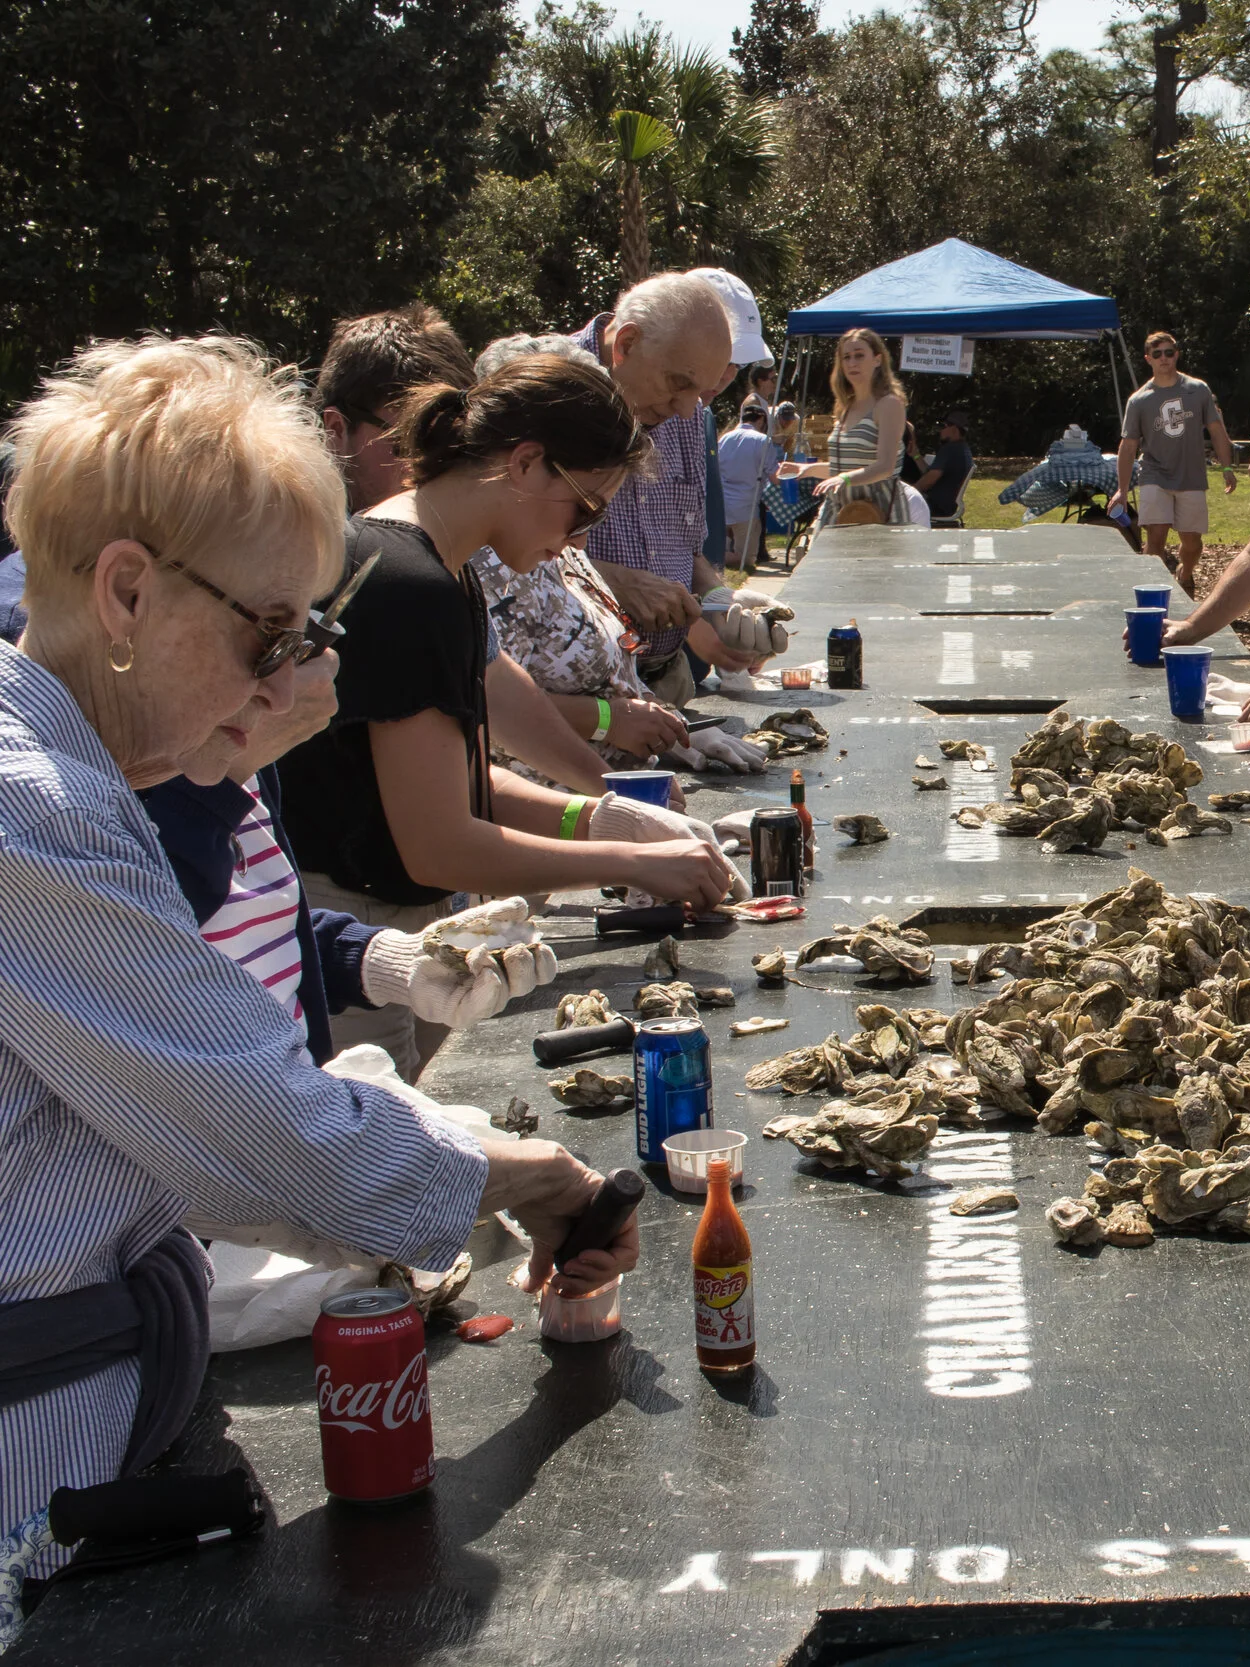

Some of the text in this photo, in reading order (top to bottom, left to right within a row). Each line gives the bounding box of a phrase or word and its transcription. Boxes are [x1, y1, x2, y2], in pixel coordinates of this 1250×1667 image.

[935, 357, 956, 367] Tickets
[824, 894, 935, 905] ONL
[636, 1053, 650, 1153] BUD LIGHT
[709, 1277, 743, 1301] PETE
[337, 1315, 413, 1337] ORIGINAL TASTE
[658, 1546, 1010, 1591] ONLY
